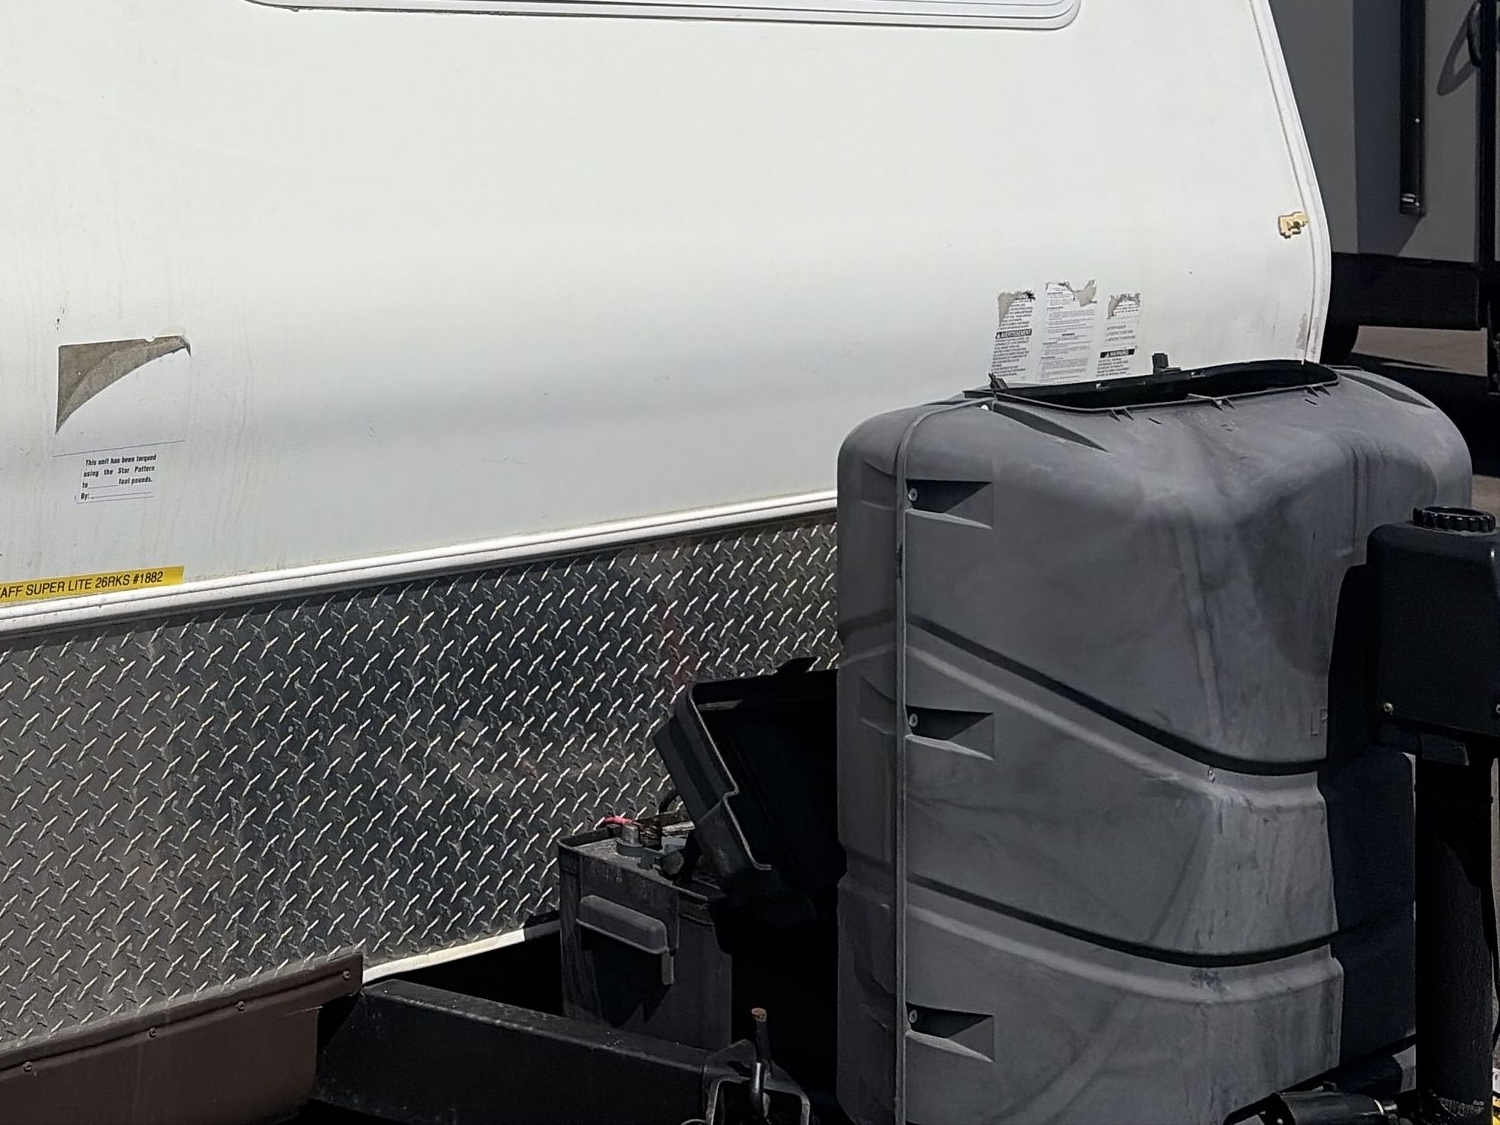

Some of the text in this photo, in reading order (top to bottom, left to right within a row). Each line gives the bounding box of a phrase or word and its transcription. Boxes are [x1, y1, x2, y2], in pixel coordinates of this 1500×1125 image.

[136, 454, 157, 462] torqued
[84, 470, 99, 478] using
[25, 581, 65, 596] SUPER
[68, 578, 93, 592] LITE
[95, 575, 130, 589] 26RKS
[132, 571, 164, 585] #1882
